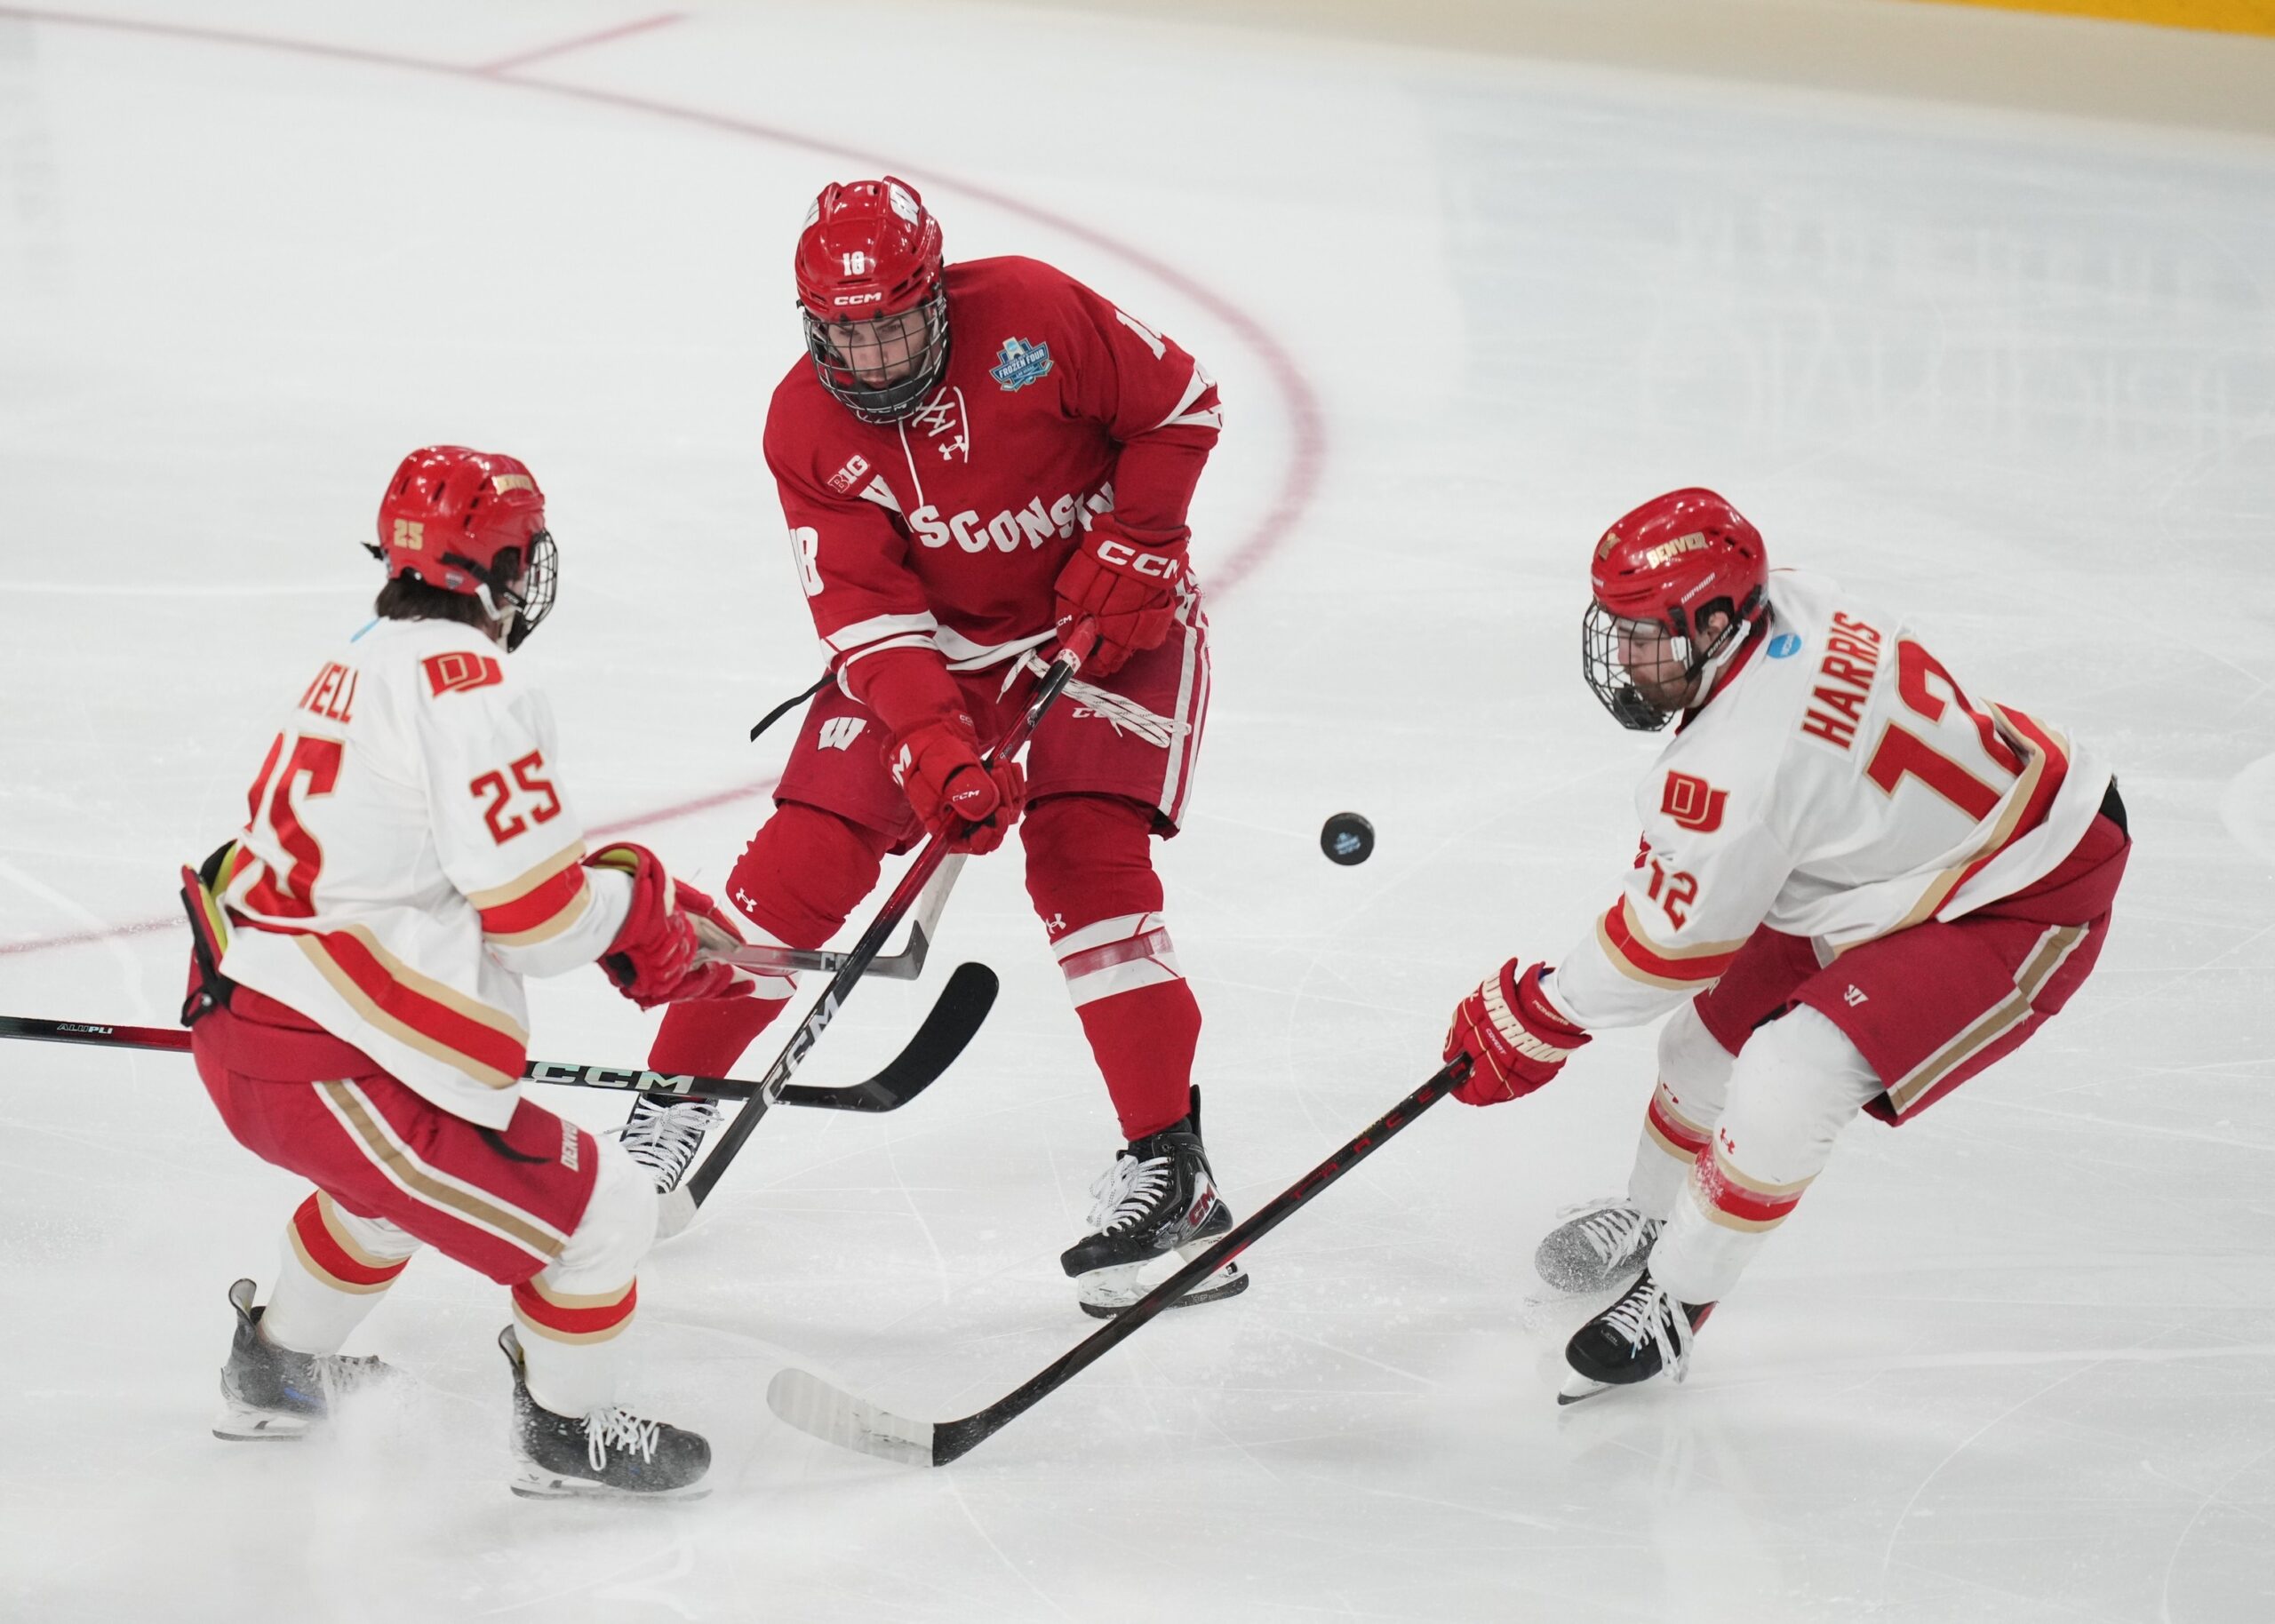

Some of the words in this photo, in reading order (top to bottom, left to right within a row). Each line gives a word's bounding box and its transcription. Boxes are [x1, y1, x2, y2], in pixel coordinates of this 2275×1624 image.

[842, 251, 866, 276] 18
[834, 292, 882, 306] CCM
[998, 357, 1026, 378] FROZEN
[1026, 348, 1045, 364] FOUR
[394, 518, 424, 551] 25
[1646, 531, 1708, 569] DENVER
[1056, 615, 1073, 627] CM
[299, 662, 358, 725] ELL
[1800, 611, 1881, 751] HARRIS
[1073, 708, 1110, 719] CC
[1864, 634, 2027, 825] 12
[818, 716, 867, 752] W
[469, 749, 562, 846] 25
[952, 789, 979, 802] CCM
[1660, 769, 1730, 833] DU
[1647, 856, 1699, 934] 12
[1481, 968, 1581, 1063] WARRIO
[1532, 999, 1569, 1026] PIONEERS
[762, 991, 839, 1109] CCM
[1486, 1028, 1507, 1055] COVERT
[532, 1062, 694, 1094] CCM
